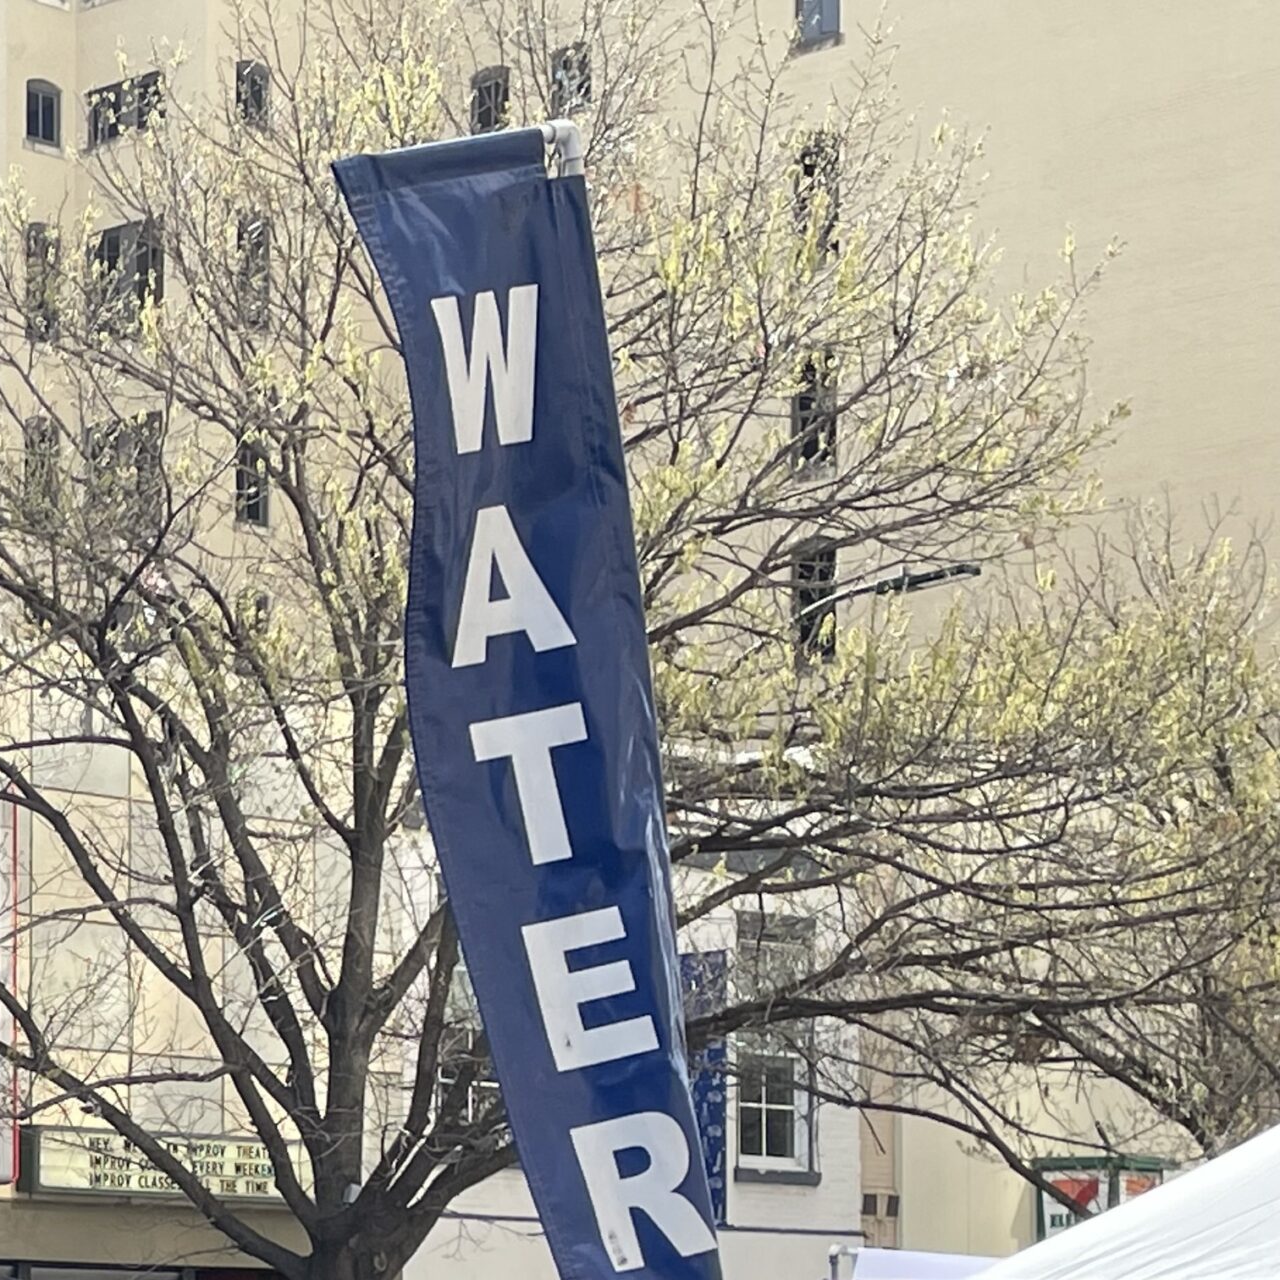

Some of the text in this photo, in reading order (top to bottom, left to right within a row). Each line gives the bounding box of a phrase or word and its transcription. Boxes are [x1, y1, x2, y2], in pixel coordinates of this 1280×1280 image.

[430, 283, 718, 1273] WATER
[236, 1145, 269, 1159] THEAT
[193, 1161, 225, 1175] EVERY
[234, 1162, 274, 1177] WEEKEN
[89, 1172, 132, 1187] IMPROV
[219, 1179, 237, 1193] THE
[245, 1180, 269, 1195] TIME
